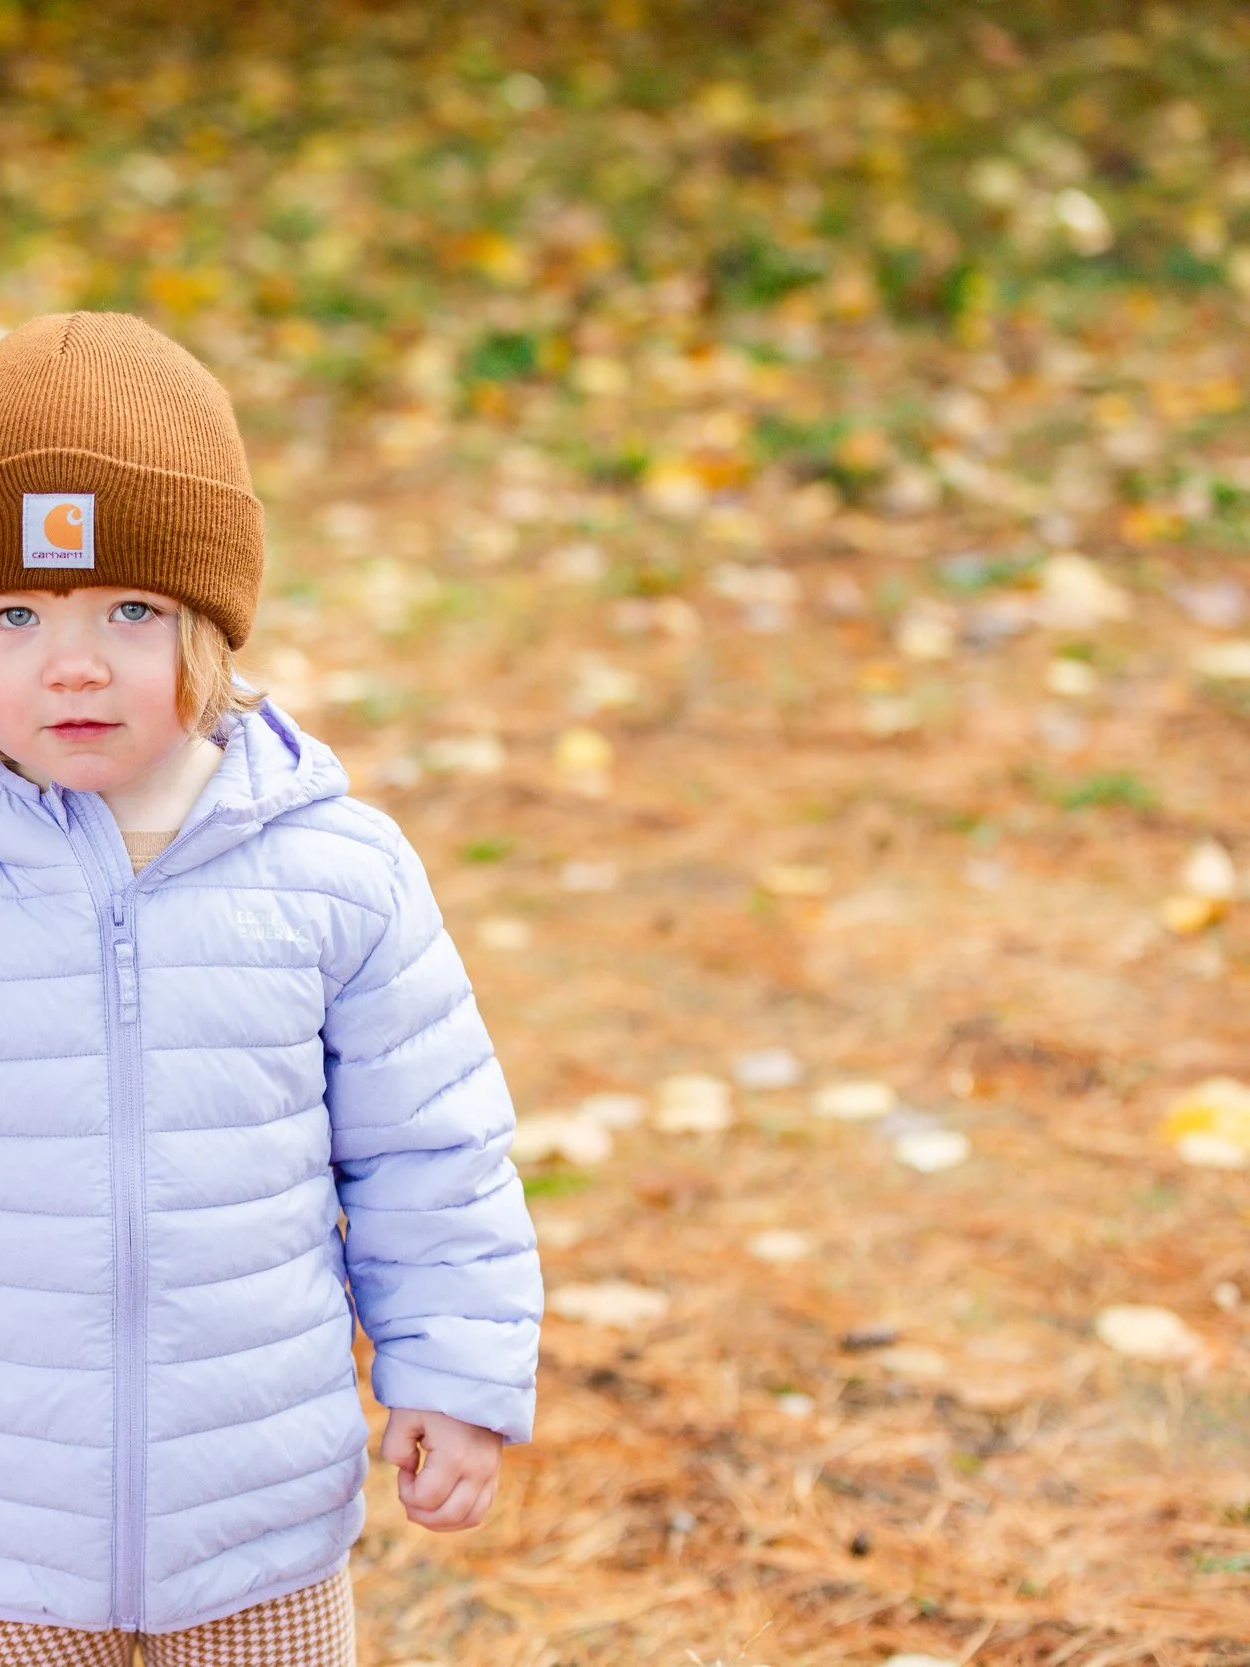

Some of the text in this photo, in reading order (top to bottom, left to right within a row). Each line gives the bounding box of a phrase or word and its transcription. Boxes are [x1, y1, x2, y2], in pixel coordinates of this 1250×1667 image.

[31, 551, 84, 559] carhartt
[237, 910, 280, 926] EDDIE
[238, 925, 285, 940] BAUER
